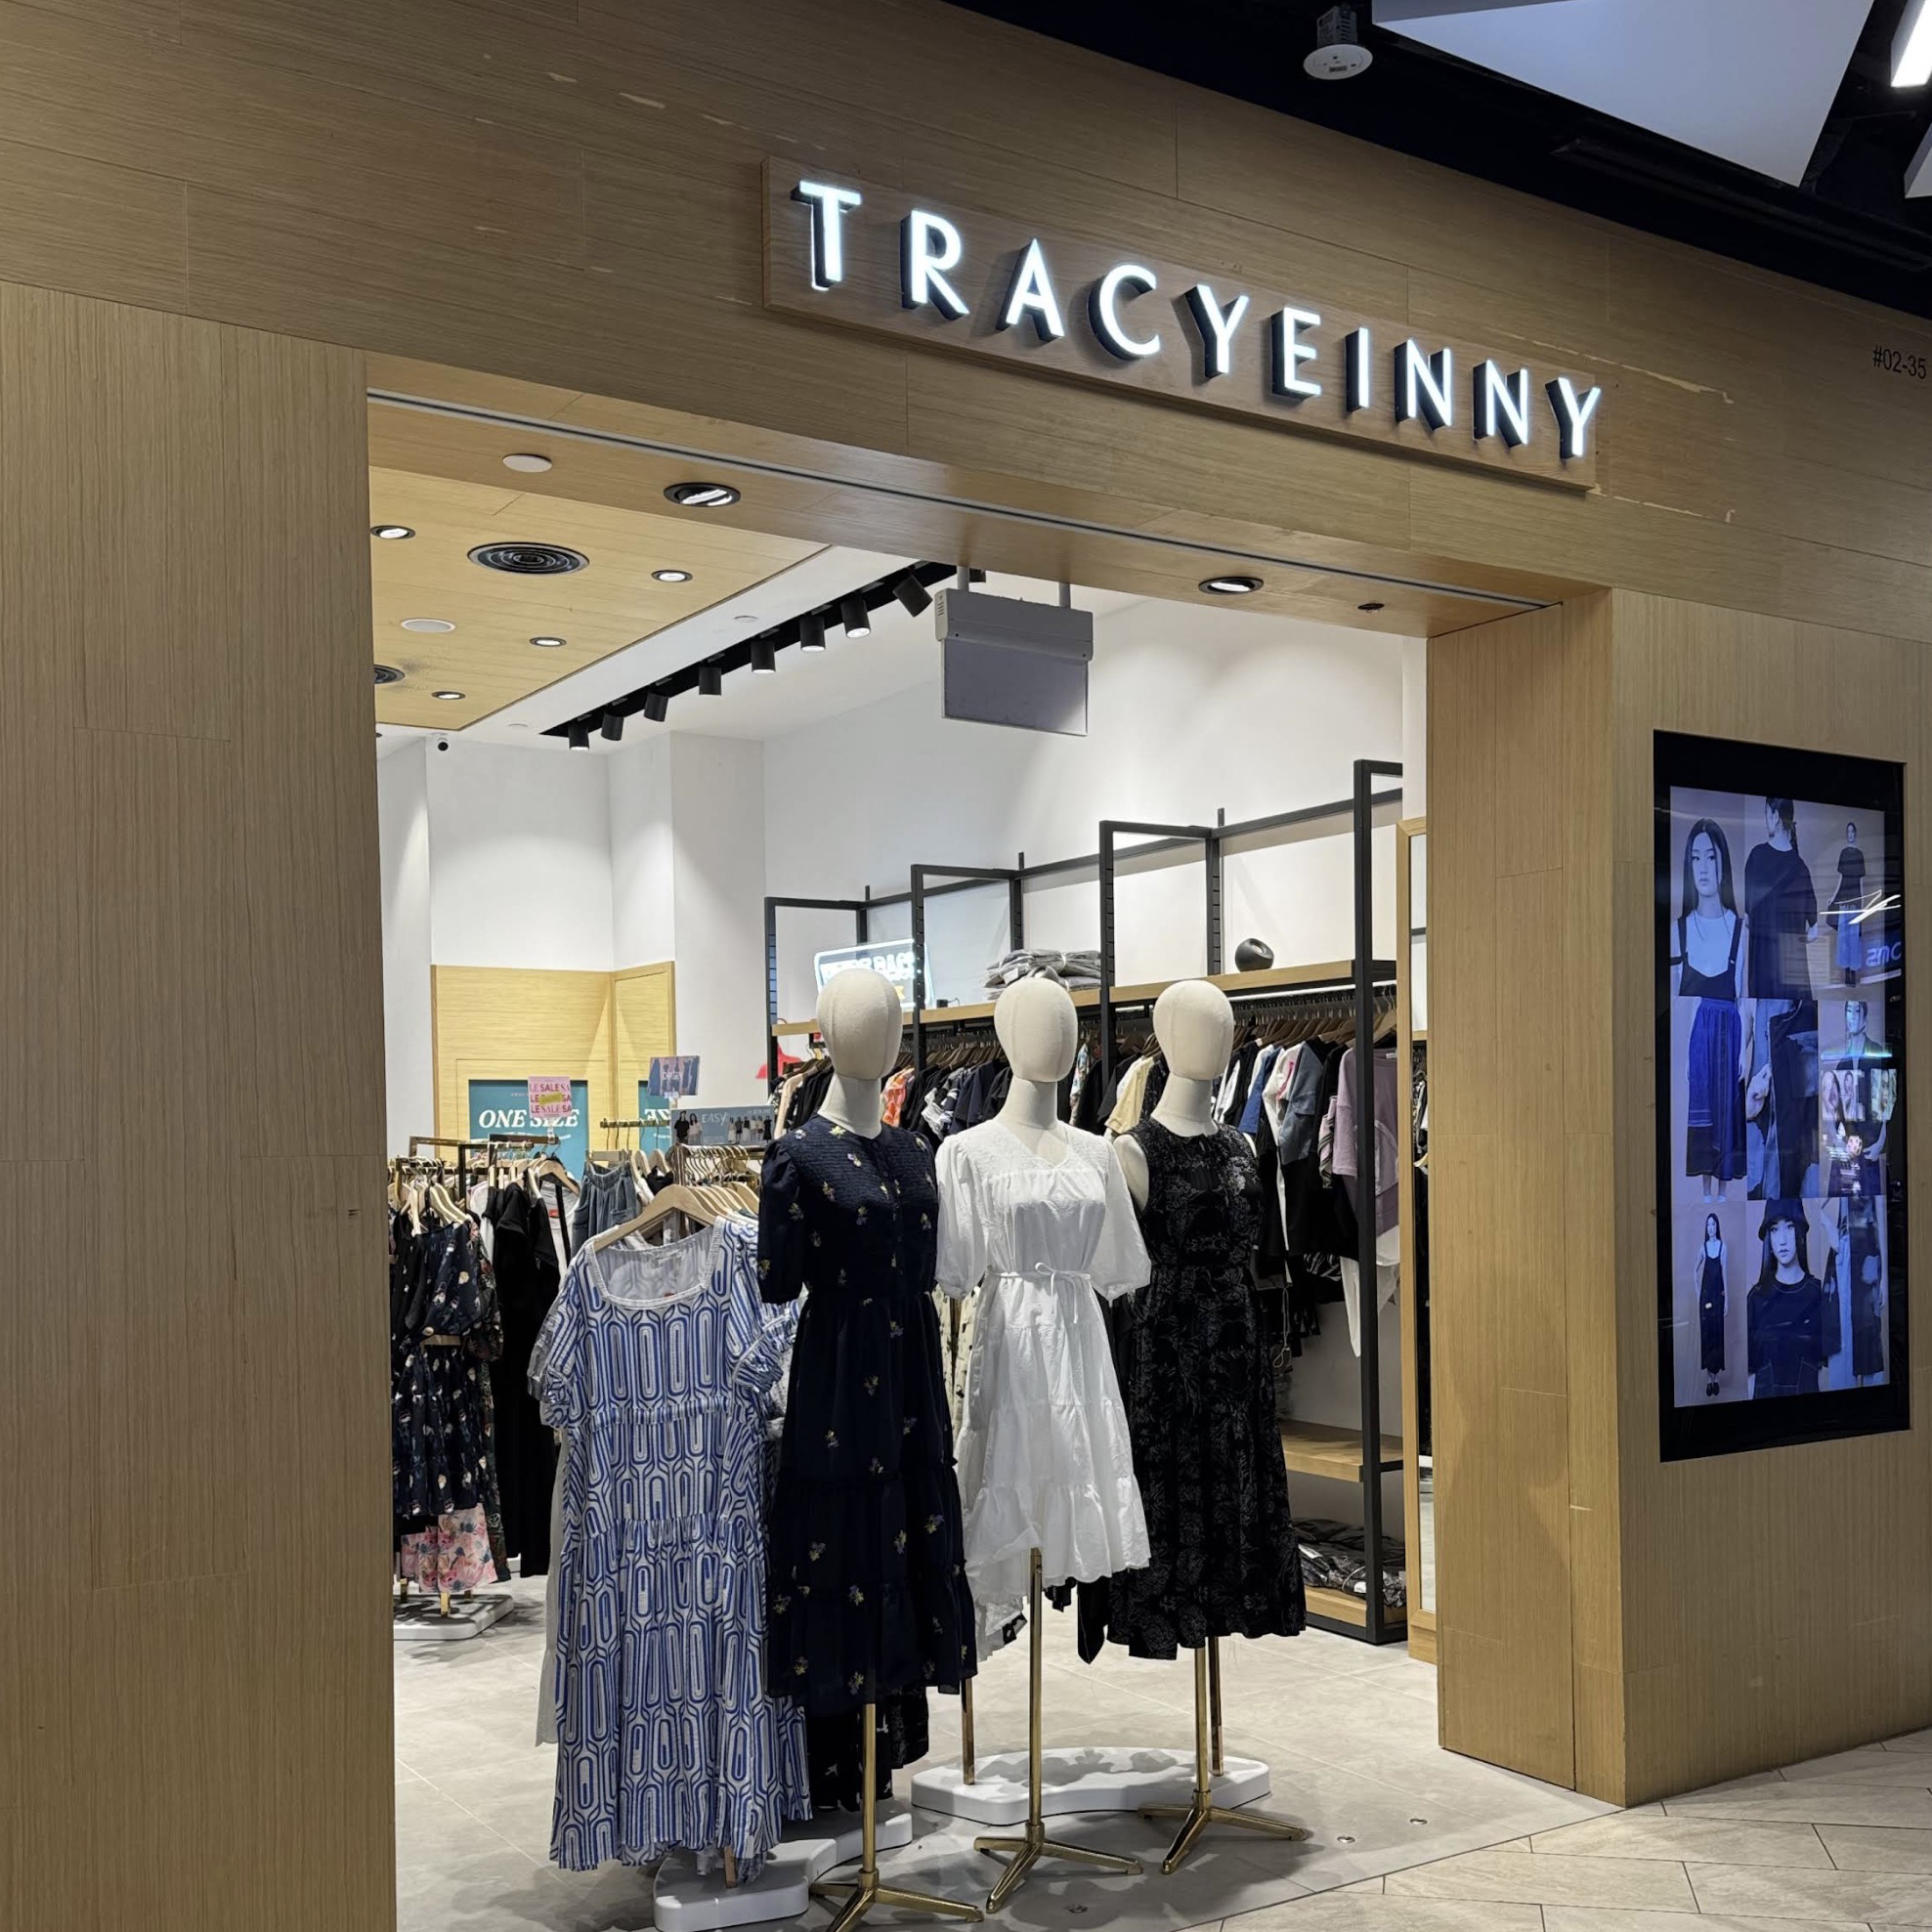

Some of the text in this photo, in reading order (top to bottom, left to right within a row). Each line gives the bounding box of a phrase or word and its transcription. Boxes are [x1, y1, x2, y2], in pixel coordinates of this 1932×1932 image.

[793, 180, 1603, 460] TRACYEINNY
[1872, 345, 1926, 379] #02-35
[479, 1109, 527, 1128] ONE
[702, 1112, 727, 1126] EASY
